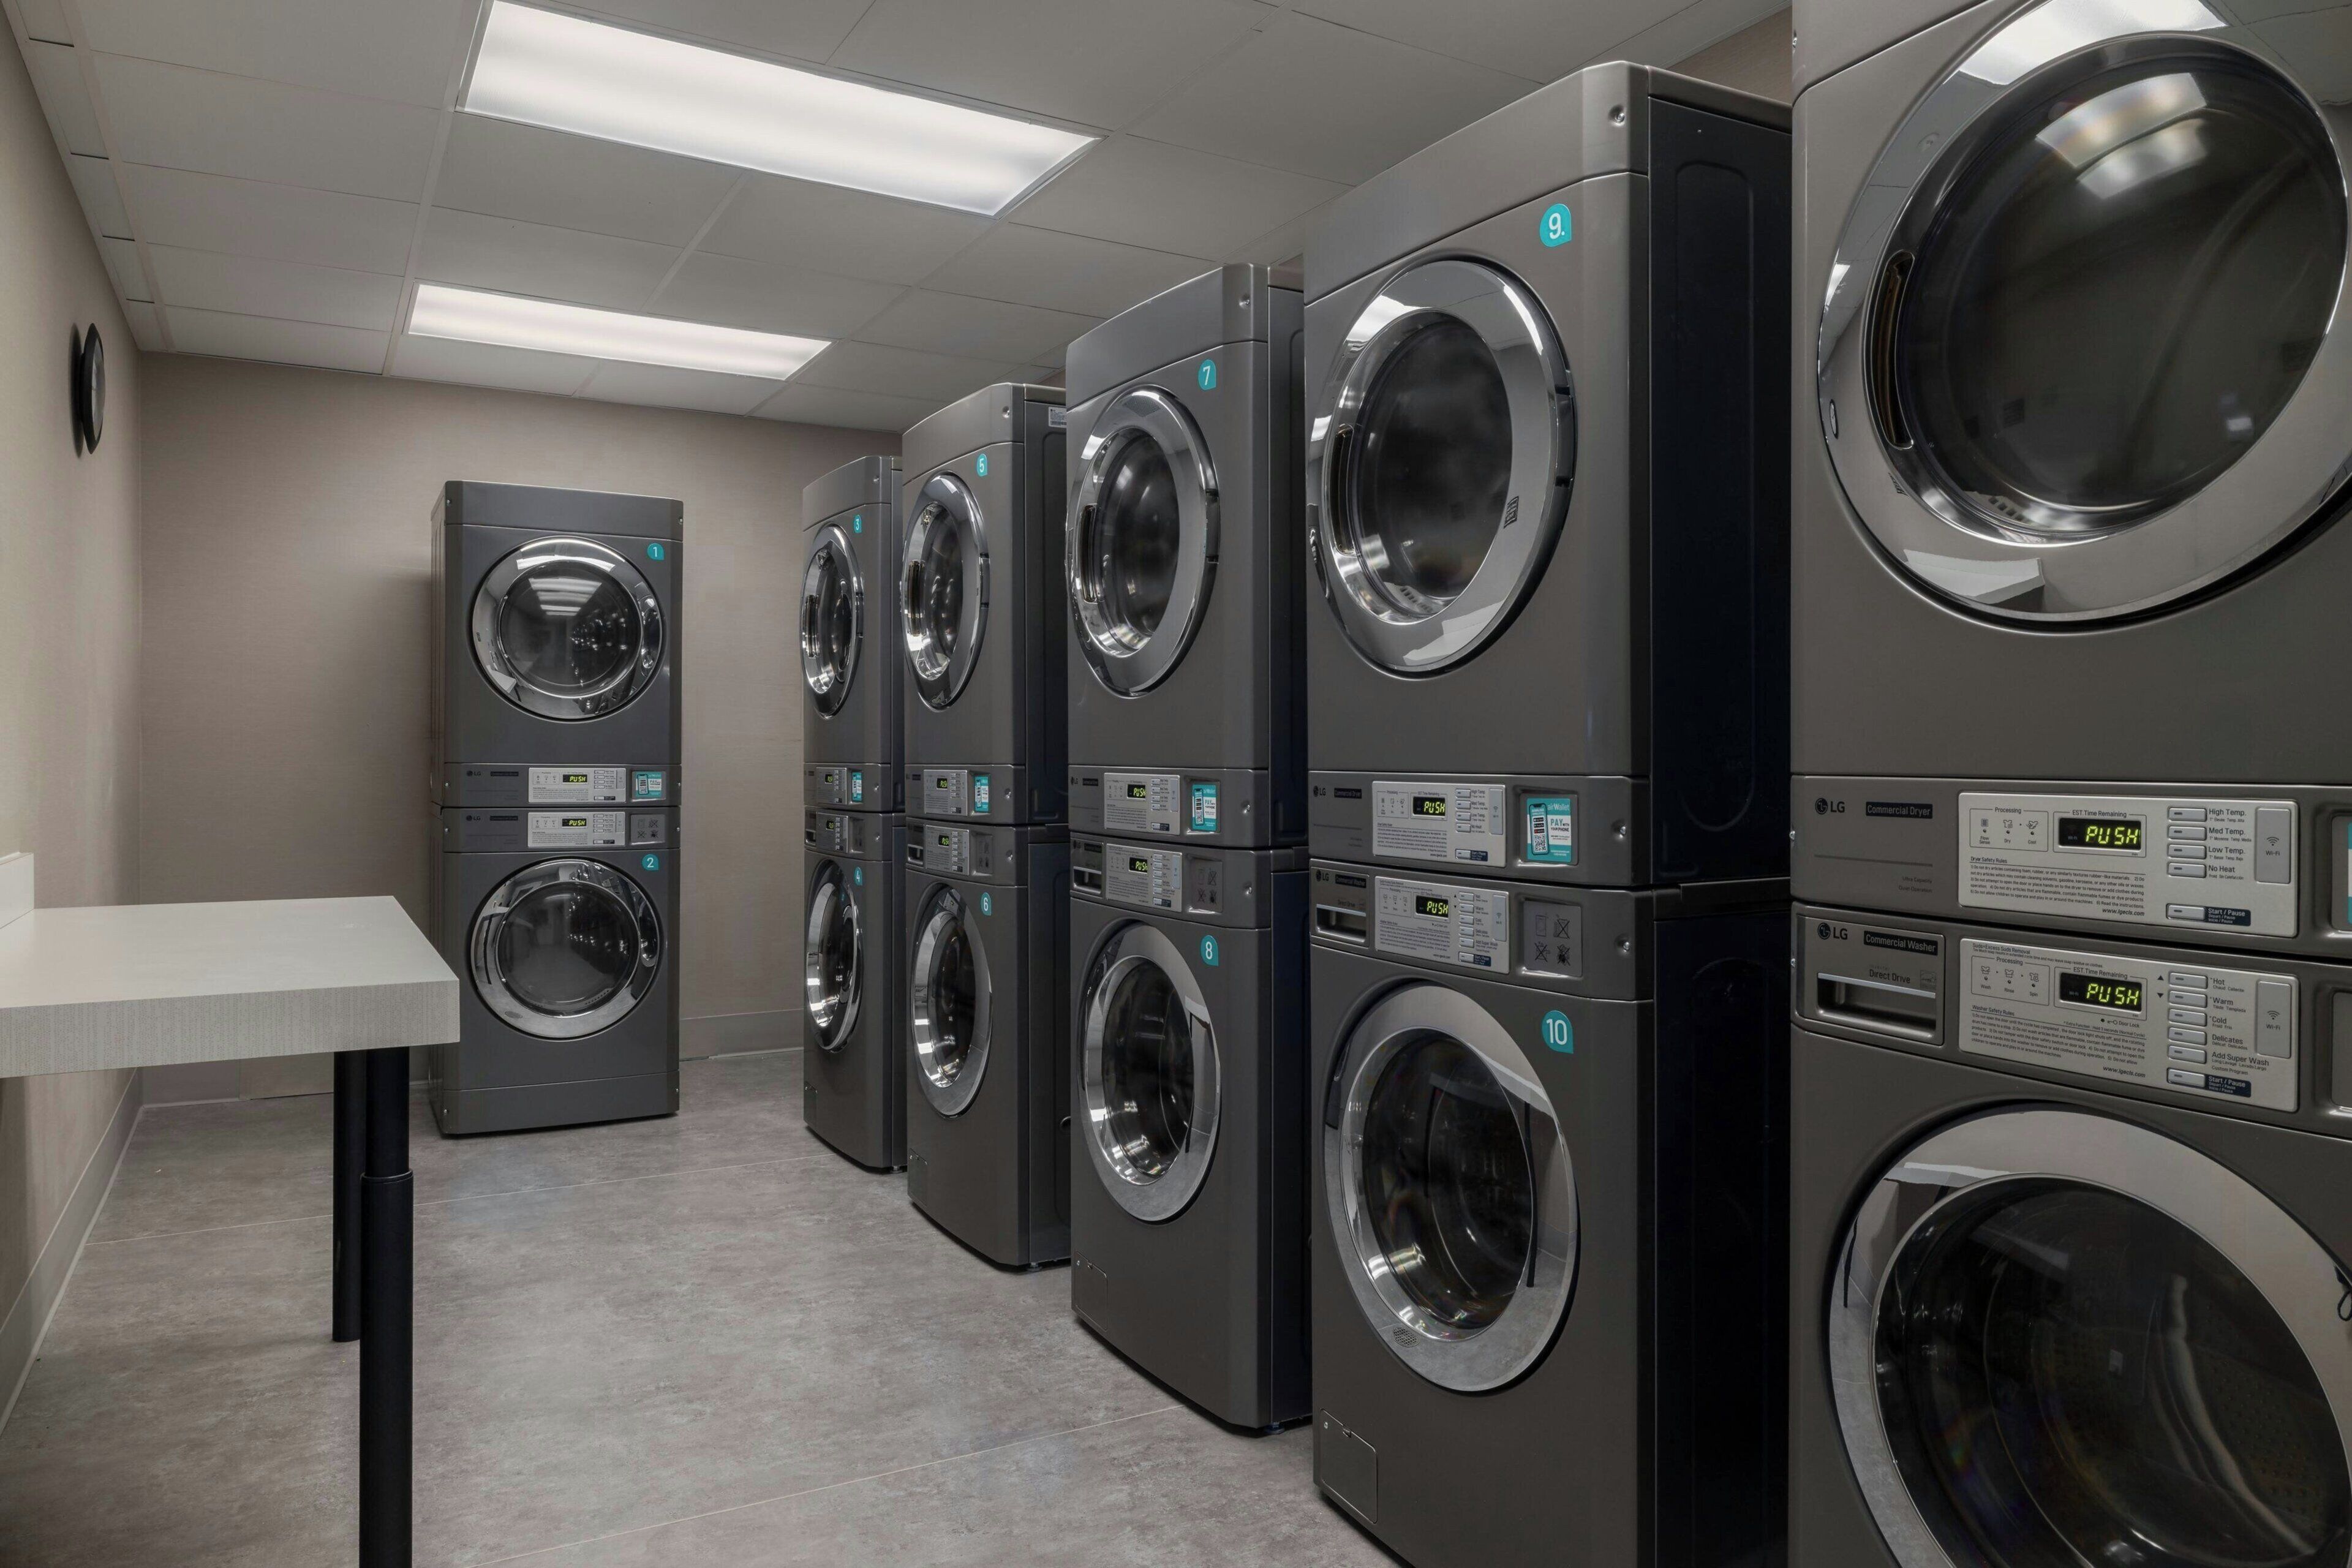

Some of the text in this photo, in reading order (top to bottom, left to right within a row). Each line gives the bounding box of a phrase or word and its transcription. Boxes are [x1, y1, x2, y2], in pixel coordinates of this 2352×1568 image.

[1203, 366, 1210, 385] 7
[979, 458, 984, 472] 5
[856, 519, 860, 530] 3
[653, 547, 658, 557] 1
[1133, 788, 1145, 797] PUSH
[1319, 788, 1326, 796] LG
[1424, 801, 1446, 813] PUSH
[1830, 801, 1845, 813] LG
[1868, 805, 1931, 817] Commercial Dryer
[2086, 826, 2139, 845] PUSH
[647, 858, 654, 867] 2
[856, 872, 860, 882] 4
[1322, 873, 1329, 881] LG
[984, 897, 989, 911] 6
[1427, 901, 1448, 914] PUSH
[1833, 927, 1848, 940] LG
[1866, 934, 1936, 952] Commercial Washer
[1205, 941, 1213, 959] 8
[1996, 957, 2023, 966] Processing
[1869, 969, 1890, 981] Direct
[1892, 973, 1910, 984] Drive
[2099, 970, 2128, 980] Remaining
[2086, 983, 2139, 1006] PUSH
[1546, 1018, 1567, 1046] 10
[2212, 1034, 2243, 1044] Delicates
[2227, 1054, 2247, 1062] Super
[2249, 1057, 2269, 1066] Wash
